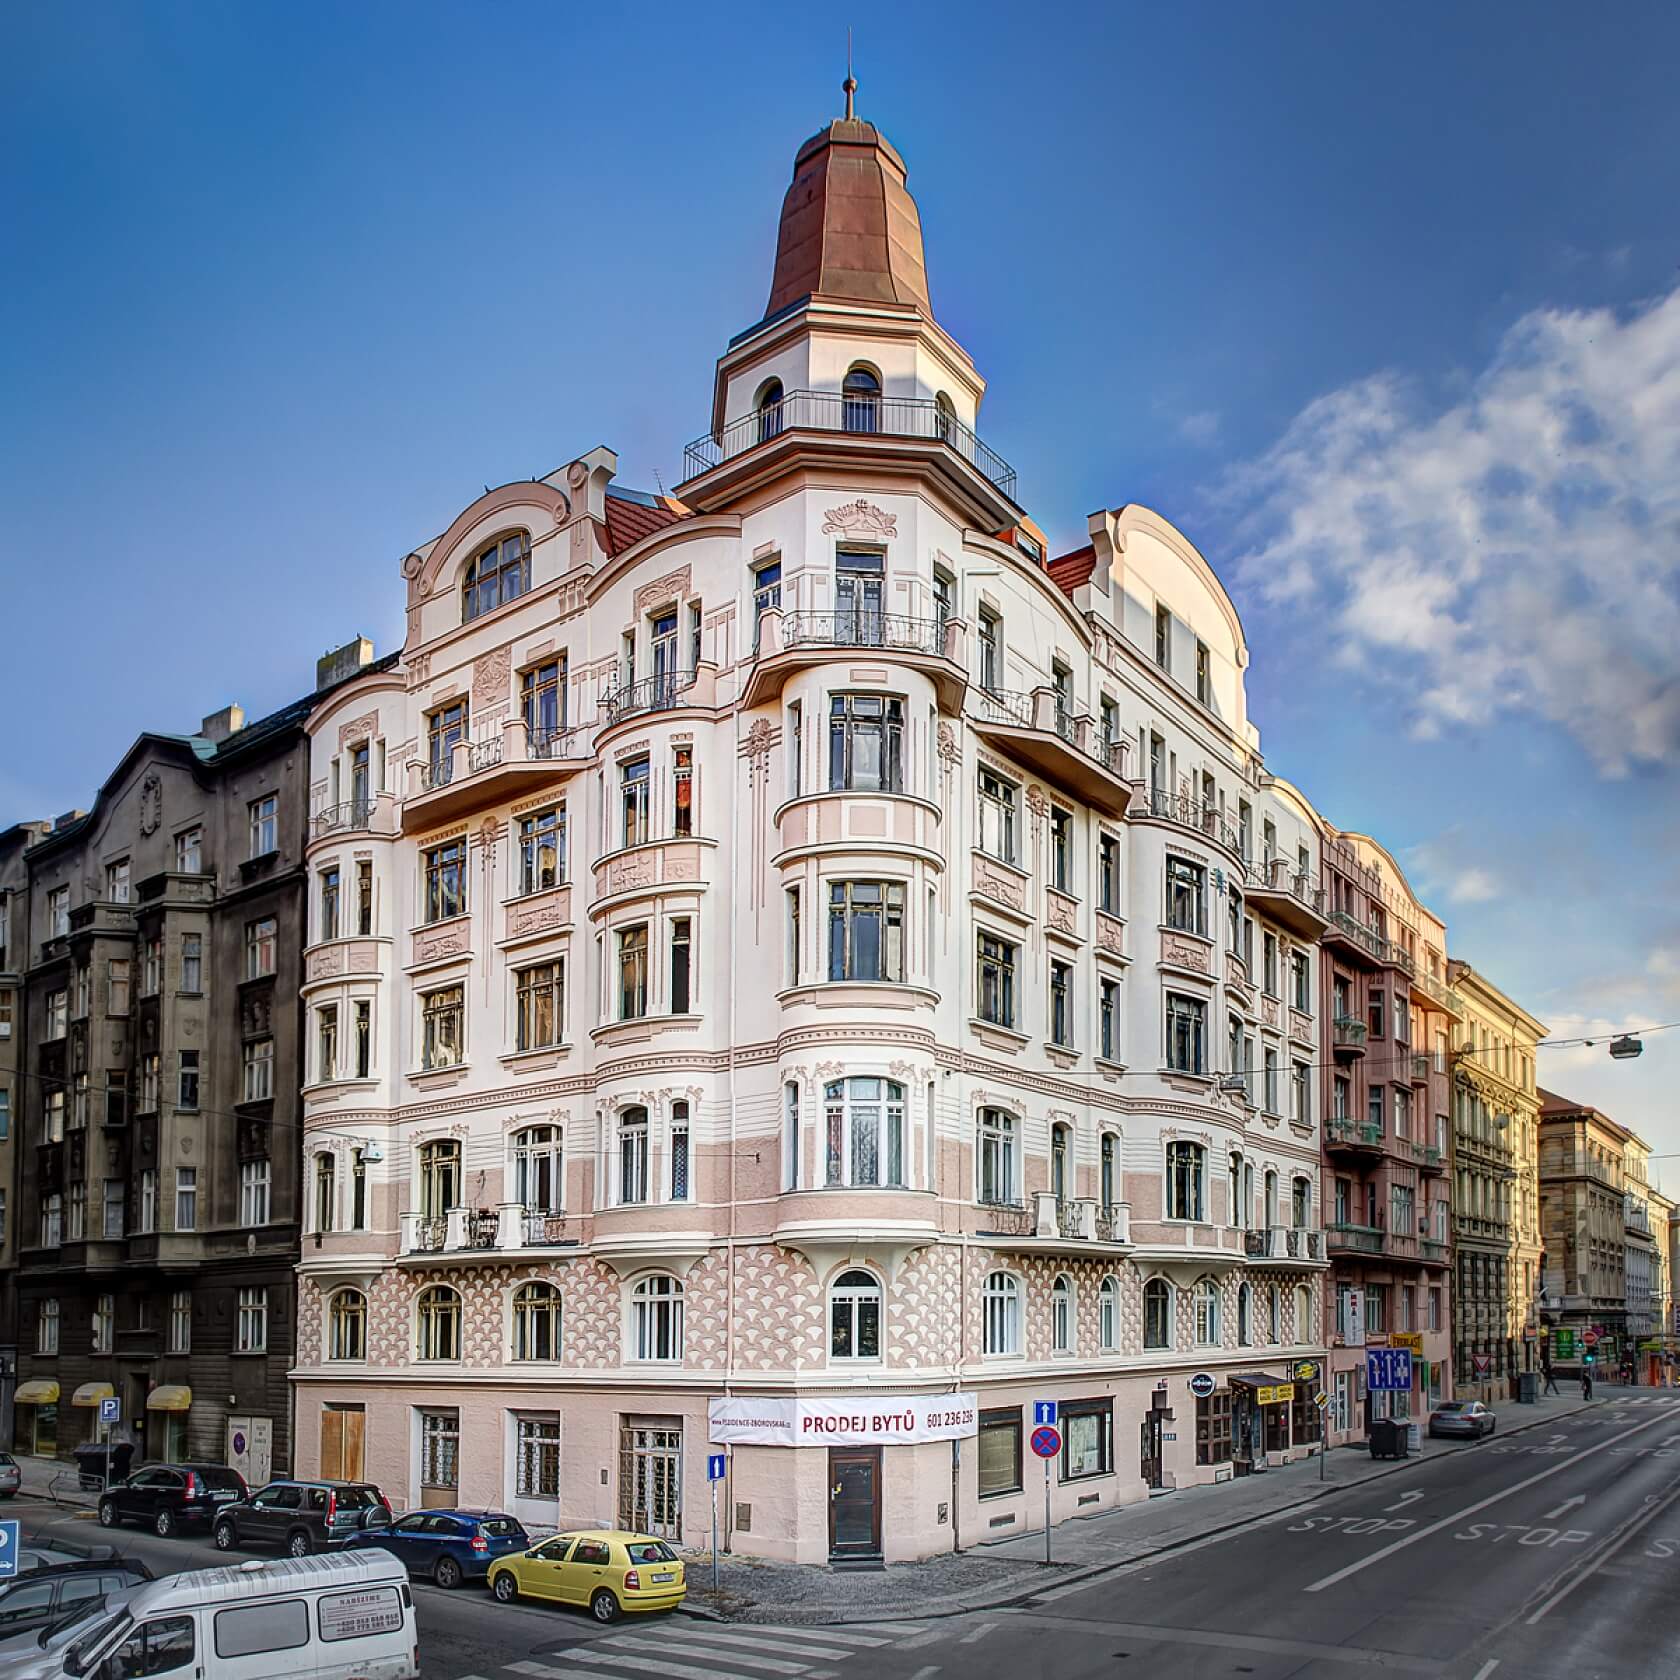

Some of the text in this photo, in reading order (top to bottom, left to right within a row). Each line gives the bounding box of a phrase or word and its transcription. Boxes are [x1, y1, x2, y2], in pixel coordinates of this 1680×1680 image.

[104, 1401, 116, 1415] P
[803, 1410, 915, 1433] PRODEJ BYTŮ
[927, 1413, 942, 1428] 601
[945, 1411, 961, 1426] 236
[1287, 1516, 1417, 1535] STOP
[1454, 1523, 1595, 1548] STOP
